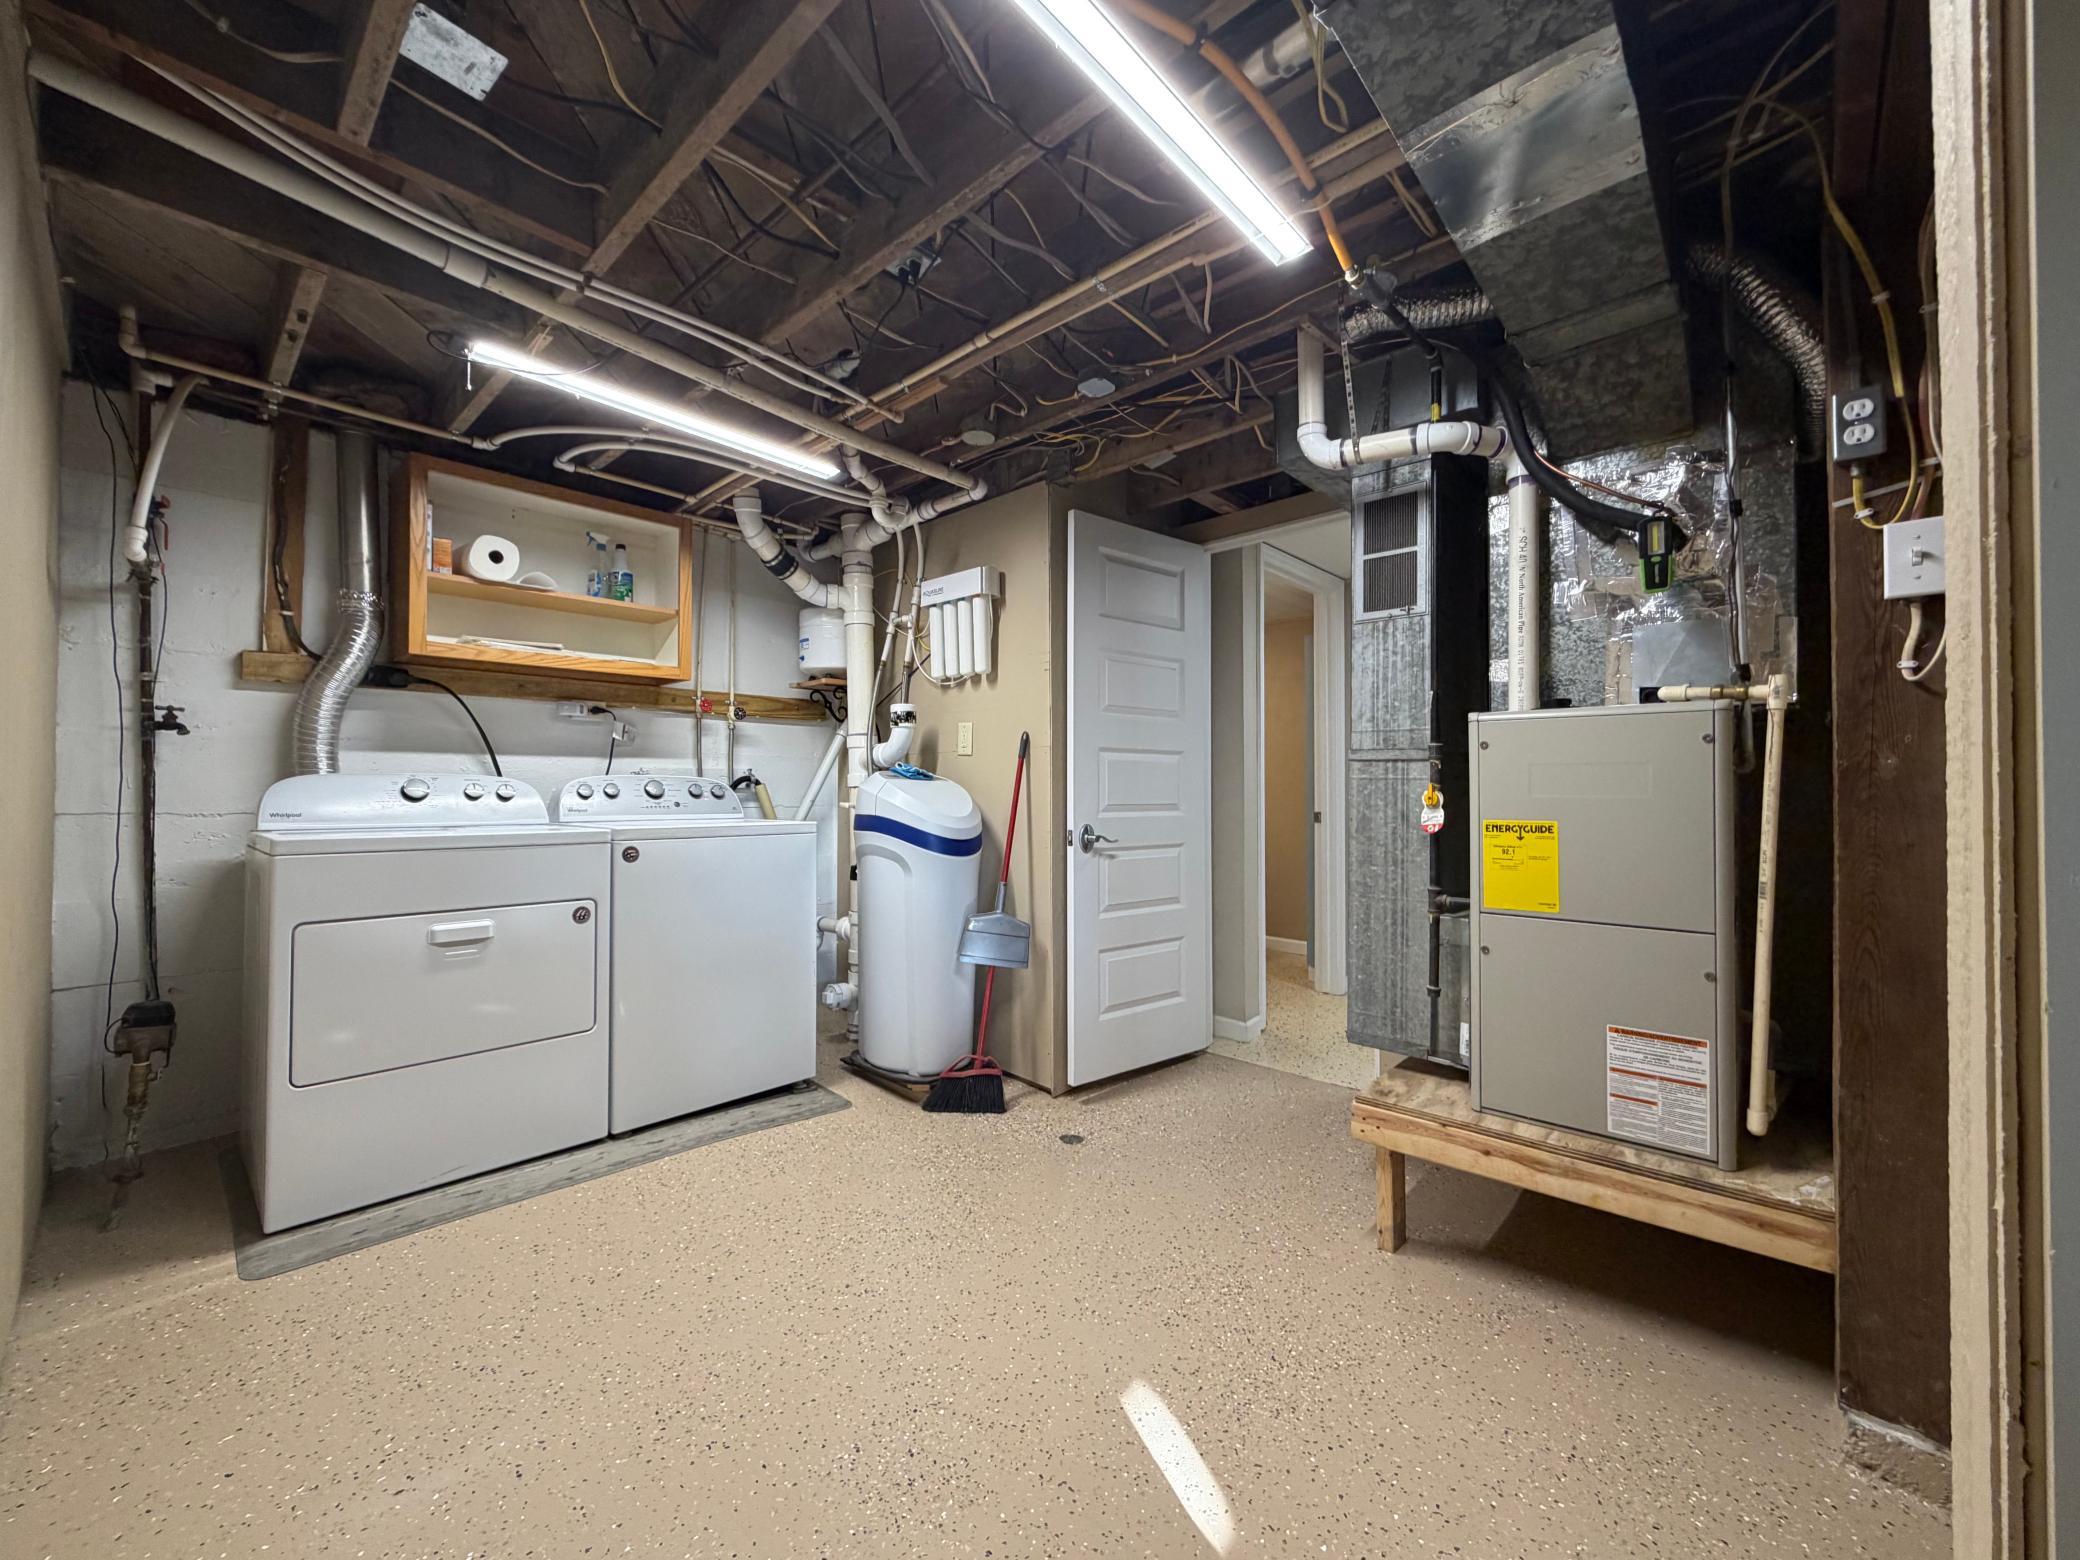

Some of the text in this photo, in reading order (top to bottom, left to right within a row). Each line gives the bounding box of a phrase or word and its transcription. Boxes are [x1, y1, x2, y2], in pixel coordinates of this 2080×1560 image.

[1518, 573, 1526, 590] North
[1518, 592, 1526, 620] American
[1517, 621, 1525, 634] Pipe
[1485, 824, 1555, 834] ENERGYGUIDE
